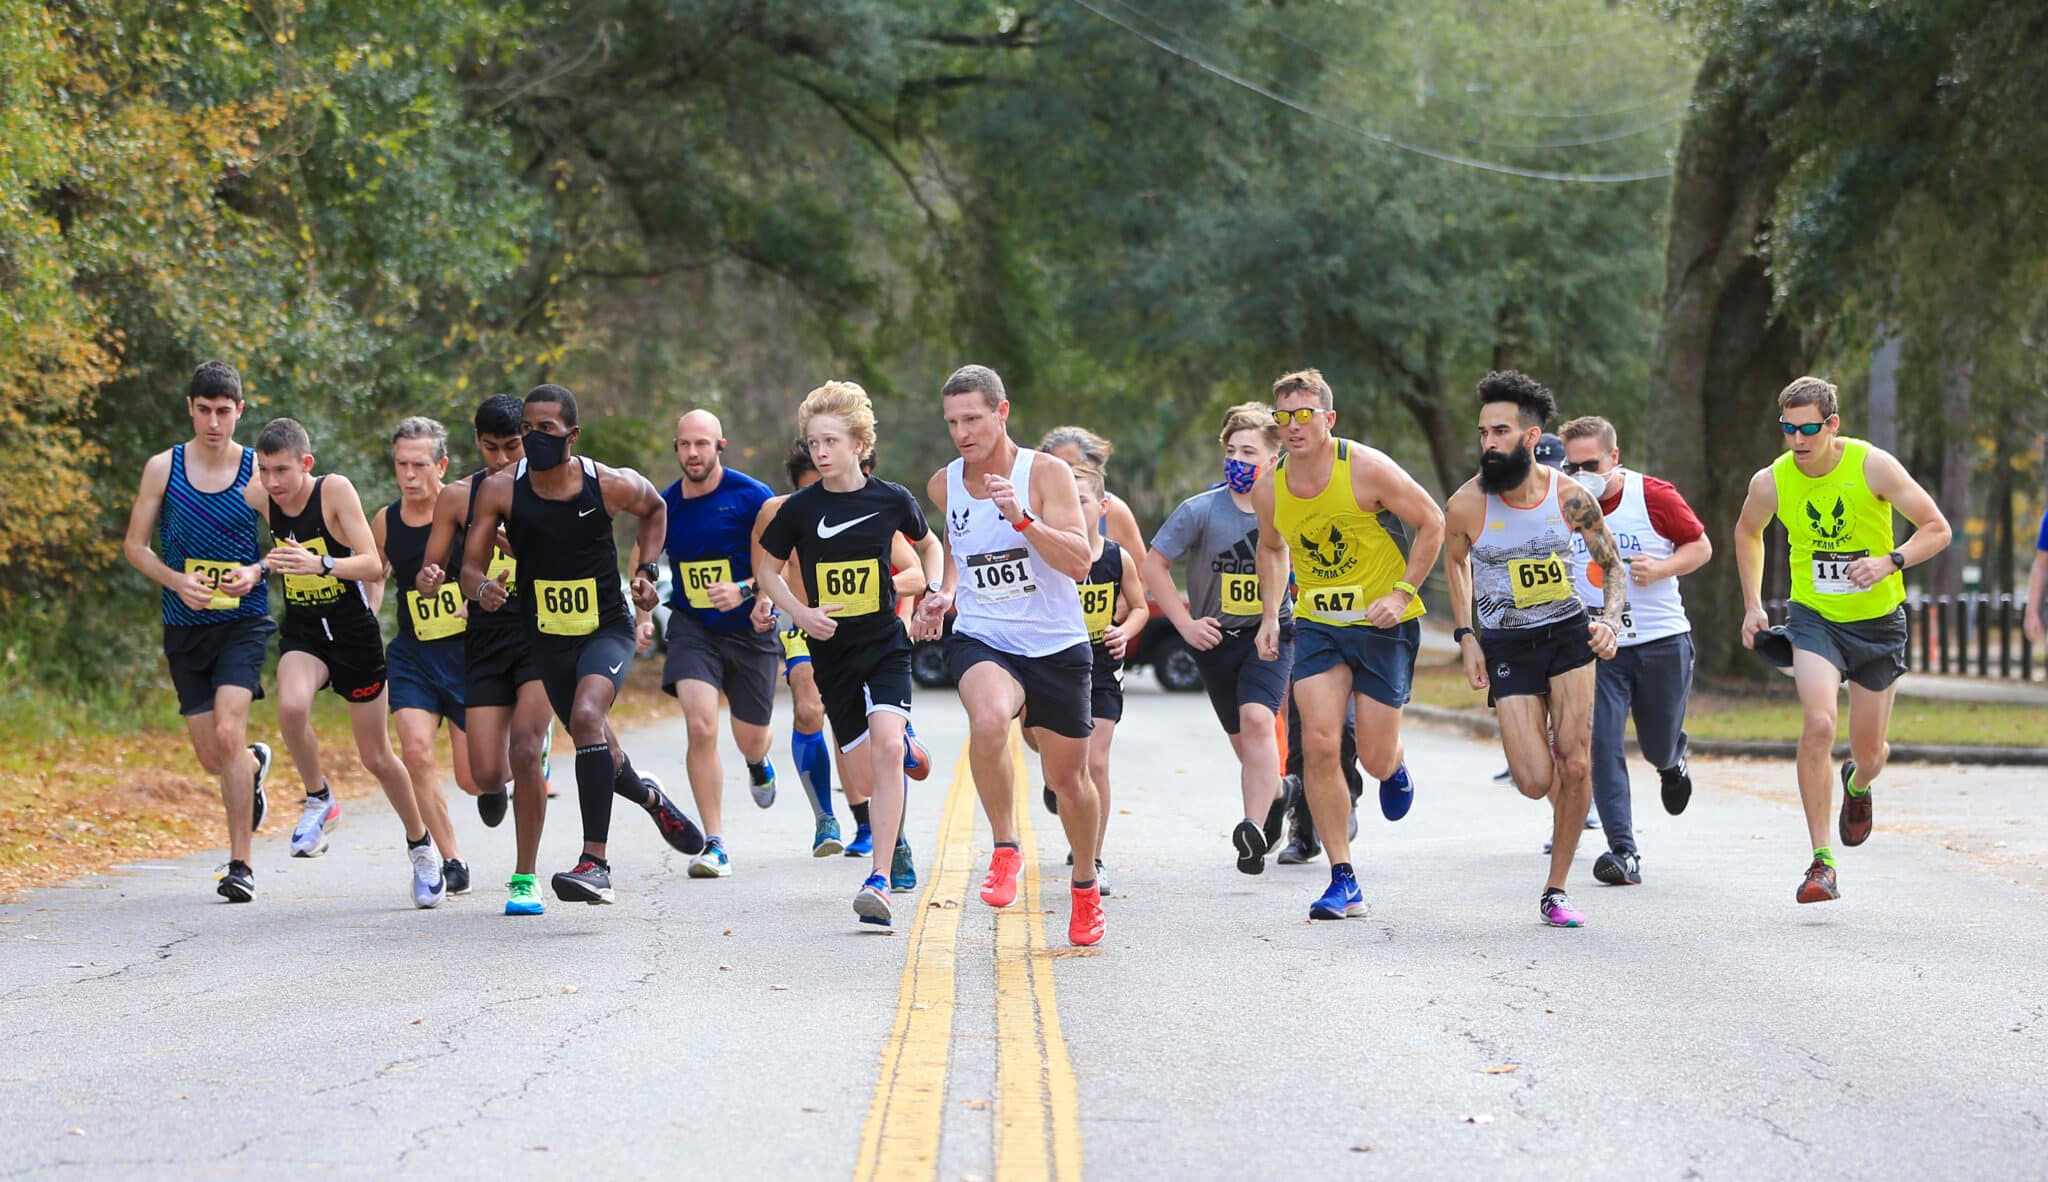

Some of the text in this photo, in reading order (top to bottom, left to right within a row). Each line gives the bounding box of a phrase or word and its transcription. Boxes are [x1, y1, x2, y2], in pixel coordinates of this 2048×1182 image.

[1812, 534, 1853, 551] TEAM FTC
[688, 566, 723, 590] 667
[826, 566, 870, 596] 687
[974, 560, 1029, 589] 1061
[1312, 557, 1358, 580] TEAM FTC
[1519, 561, 1562, 589] 659
[415, 590, 456, 620] 678
[544, 586, 589, 614] 680
[1078, 589, 1108, 614] 85
[1313, 592, 1355, 612] 647
